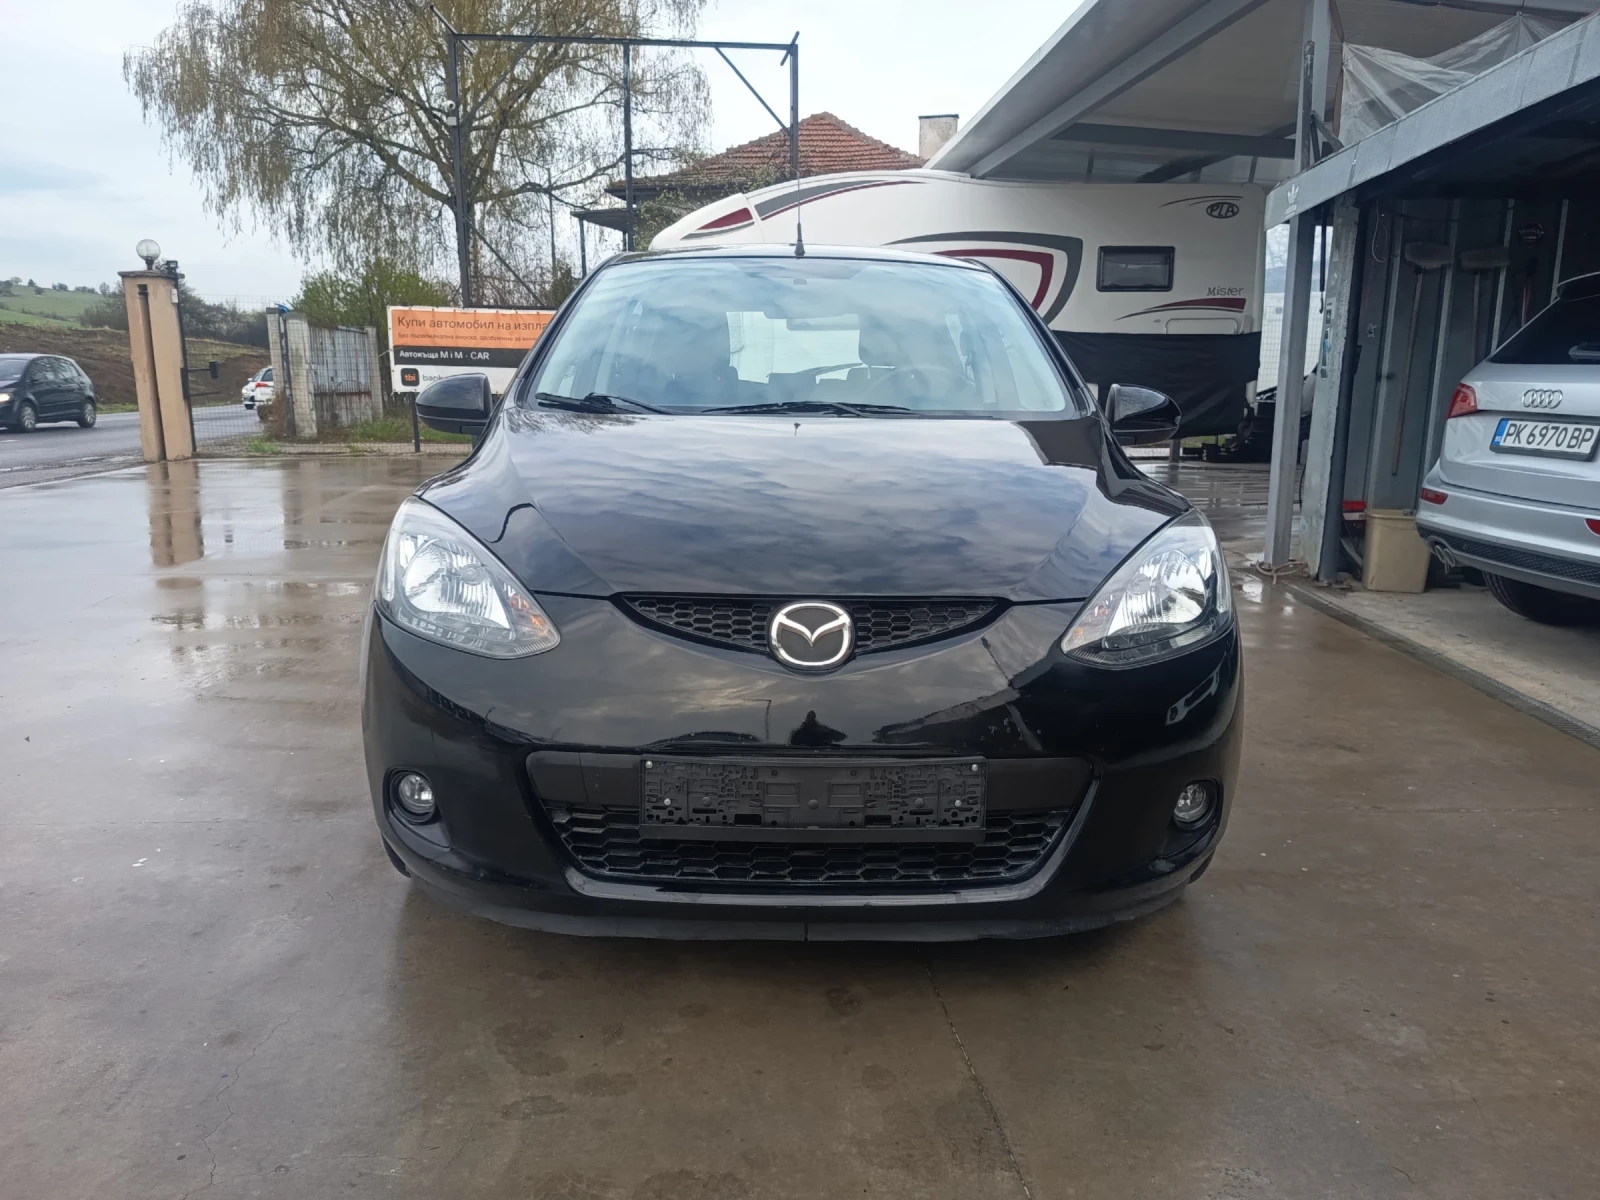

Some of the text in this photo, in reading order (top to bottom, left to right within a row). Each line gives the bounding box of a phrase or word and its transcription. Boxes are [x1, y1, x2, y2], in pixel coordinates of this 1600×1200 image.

[1208, 202, 1237, 218] PLA
[1206, 285, 1244, 296] Mister
[397, 316, 426, 329] Купи
[429, 319, 494, 330] автомобил
[497, 322, 511, 331] на
[399, 350, 439, 360] Автокъща
[470, 351, 490, 360] CAR
[404, 373, 416, 382] tbi
[1503, 423, 1594, 450] PK 6970 BP
